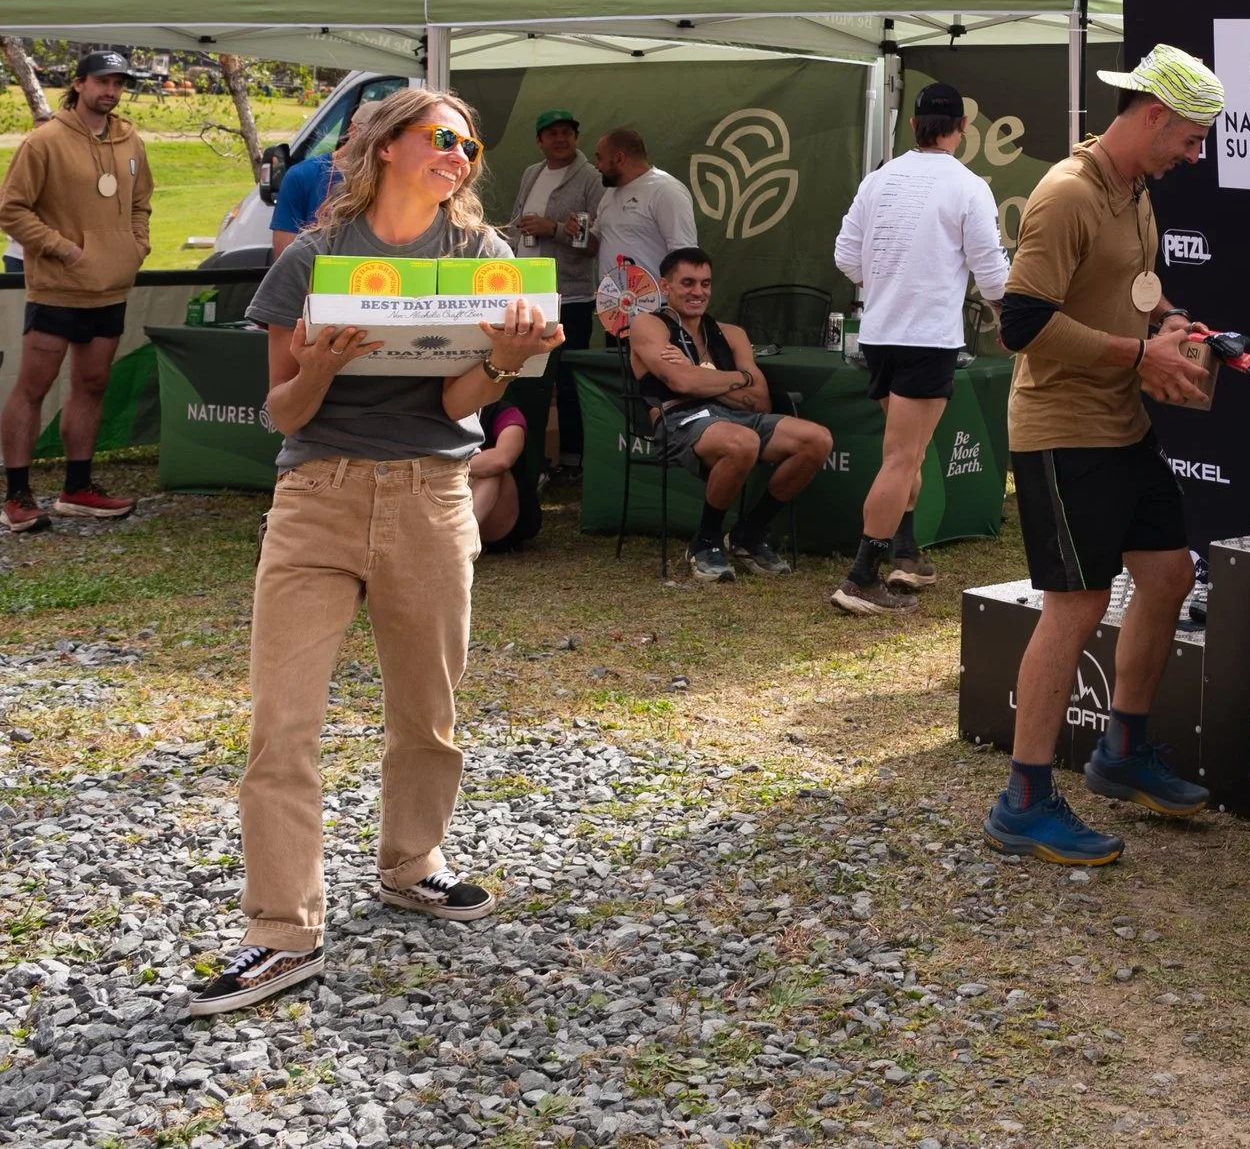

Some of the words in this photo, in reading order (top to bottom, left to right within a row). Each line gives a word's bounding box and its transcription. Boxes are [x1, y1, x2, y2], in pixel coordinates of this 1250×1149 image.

[1164, 234, 1211, 267] PETZL
[360, 264, 376, 277] DAY
[361, 300, 399, 310] BEST
[403, 301, 433, 310] DAY
[438, 299, 508, 310] BREWING
[441, 310, 464, 321] Craft
[432, 348, 493, 356] BREW
[187, 403, 255, 424] NATURES
[954, 431, 970, 447] Be
[950, 442, 981, 462] More
[946, 458, 983, 478] Earth.
